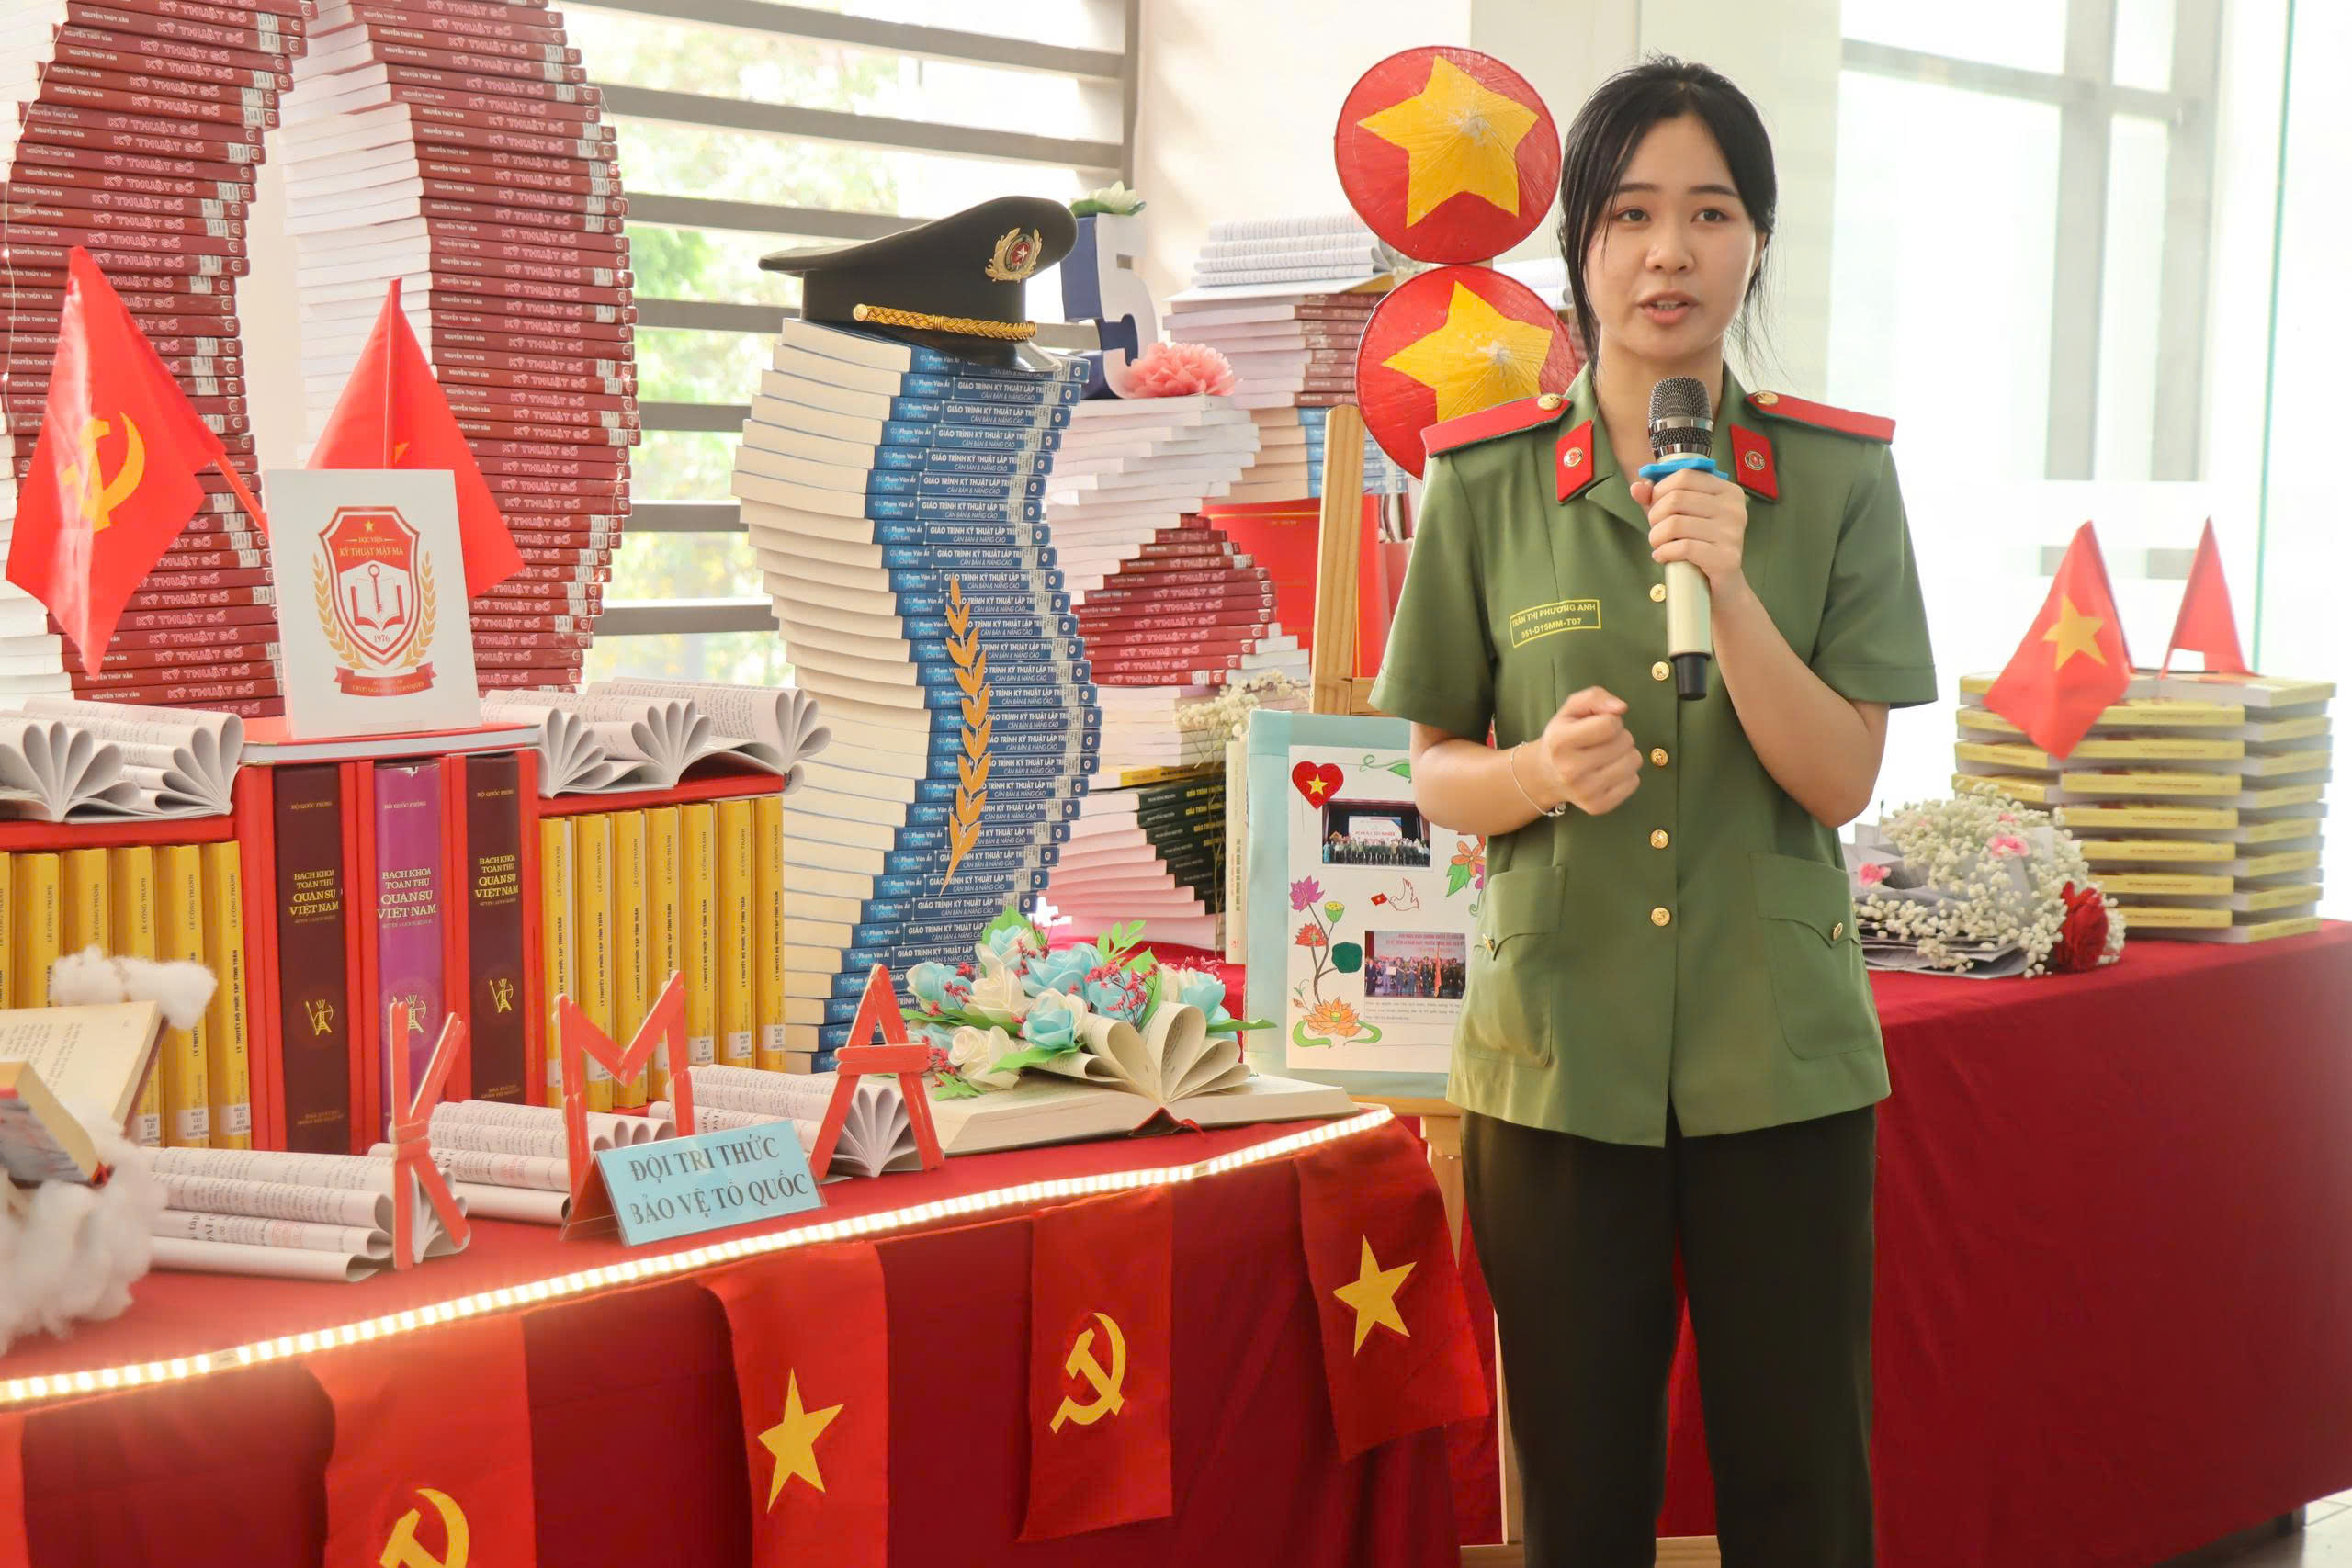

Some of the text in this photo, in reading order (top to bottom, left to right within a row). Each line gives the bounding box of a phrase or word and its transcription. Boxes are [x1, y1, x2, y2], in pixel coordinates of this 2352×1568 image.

[502, 885, 518, 896] NAM
[318, 901, 338, 911] NAM
[411, 904, 436, 917] NAM
[629, 1134, 780, 1184] ĐỘI TRI THỨC
[677, 1188, 711, 1218] VỆ
[748, 1169, 809, 1206] QUỐC
